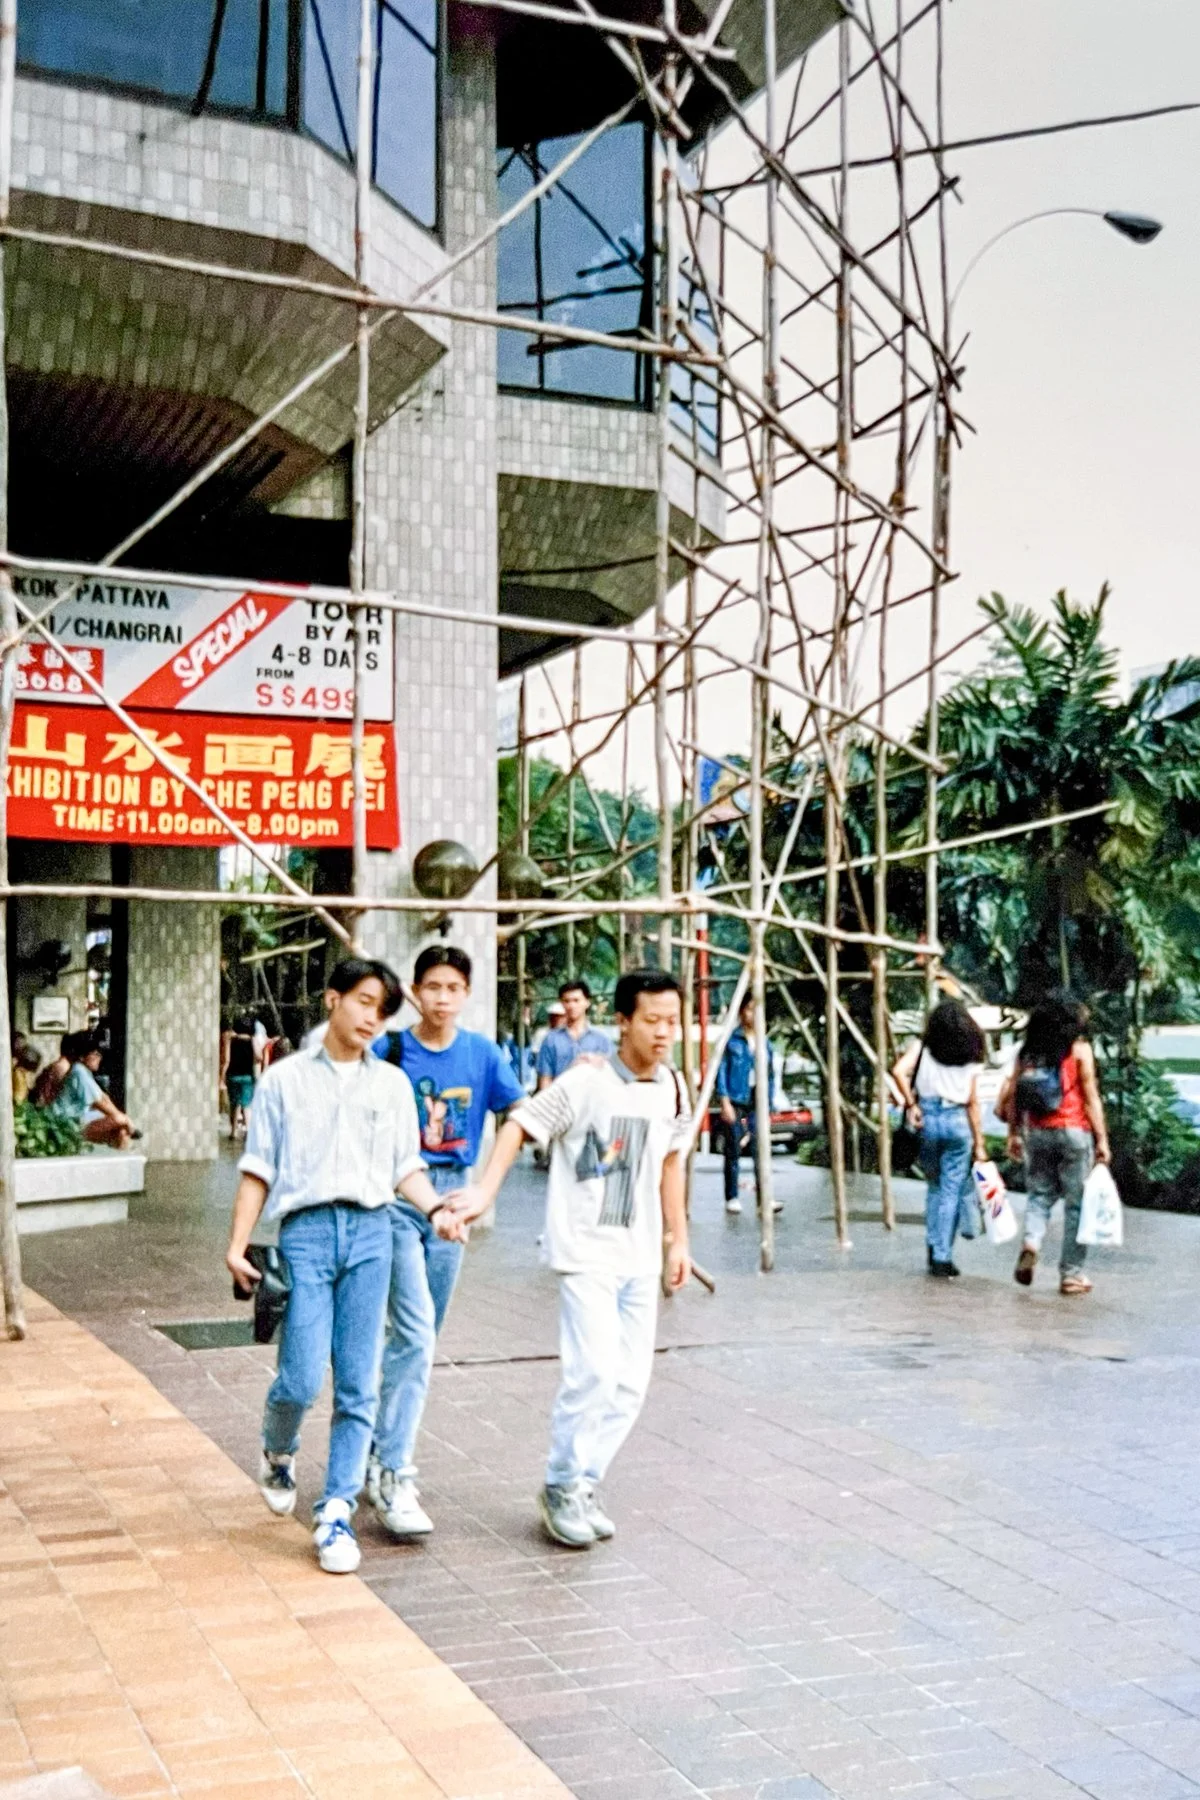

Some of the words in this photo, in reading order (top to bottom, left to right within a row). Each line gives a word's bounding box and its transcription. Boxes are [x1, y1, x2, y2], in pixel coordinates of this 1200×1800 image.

[76, 583, 170, 609] PATTAYA
[15, 607, 182, 644] I/CHANGRAI
[306, 624, 334, 641] BY
[345, 628, 380, 645] AR
[172, 598, 268, 688] SPECIAL
[272, 643, 311, 666] 4-8
[324, 648, 378, 671] DAS
[256, 667, 294, 679] FROM
[150, 777, 186, 808] BY
[201, 778, 252, 810] CHE
[262, 780, 332, 810] PENG
[341, 781, 385, 811] FEI
